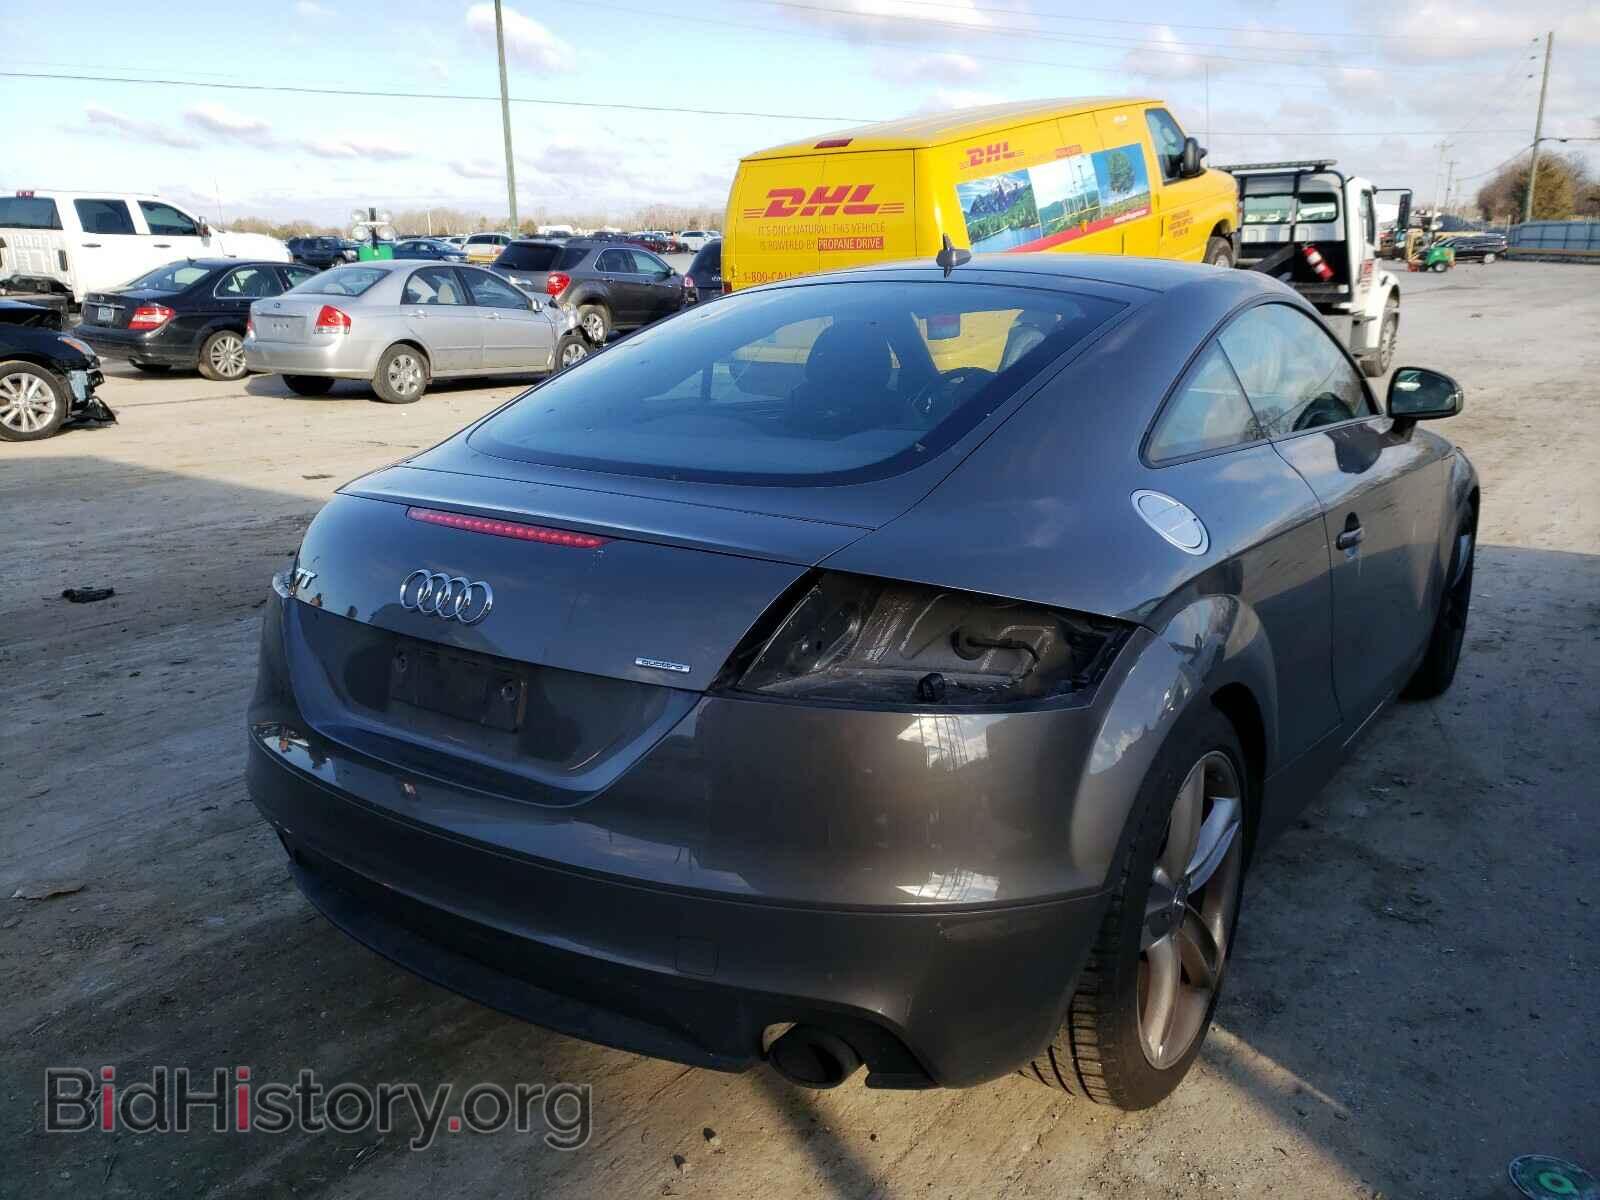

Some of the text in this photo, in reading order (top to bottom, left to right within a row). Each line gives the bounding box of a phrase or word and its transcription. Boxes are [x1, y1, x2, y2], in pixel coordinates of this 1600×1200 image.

[966, 141, 1014, 166] DHL
[763, 184, 881, 219] DHL
[833, 223, 849, 233] THIS
[851, 221, 885, 233] VEHICLE
[768, 239, 804, 250] POWERED
[806, 239, 817, 249] BY
[818, 239, 855, 249] PROPANE
